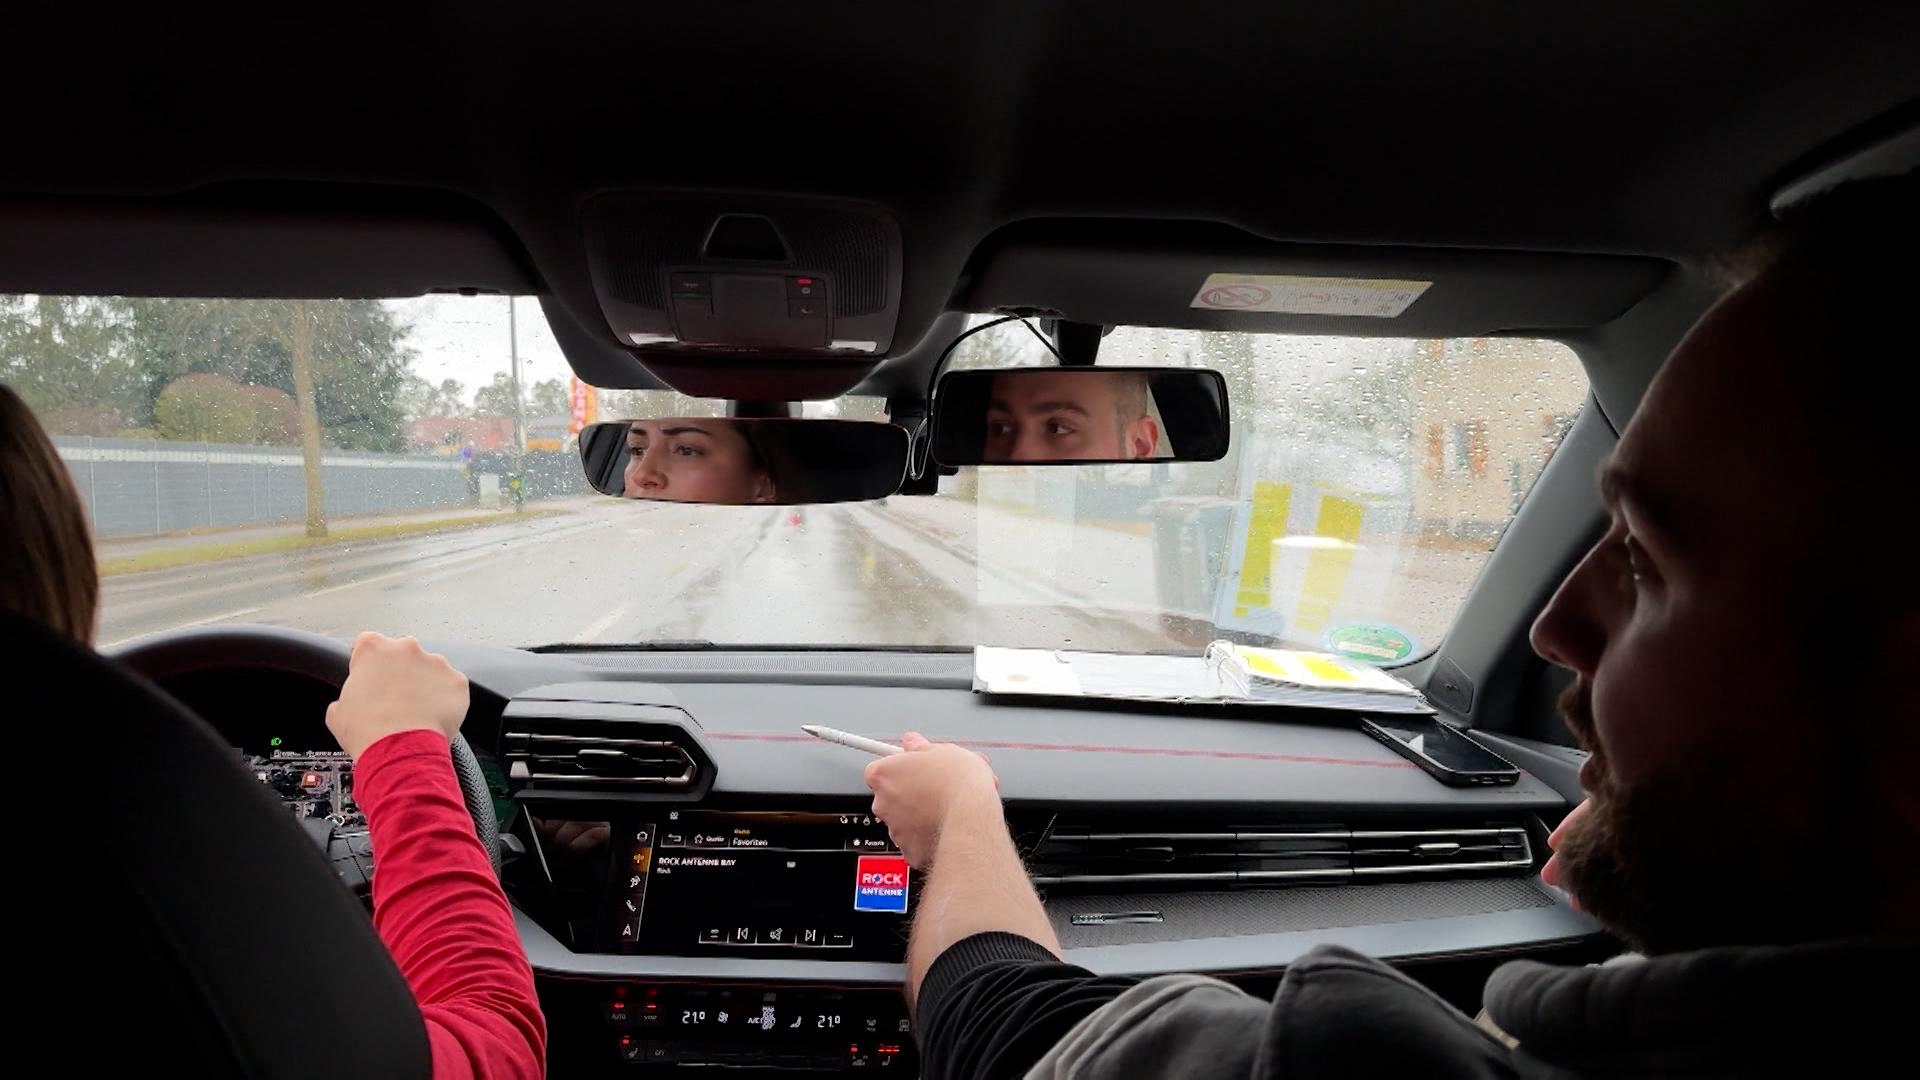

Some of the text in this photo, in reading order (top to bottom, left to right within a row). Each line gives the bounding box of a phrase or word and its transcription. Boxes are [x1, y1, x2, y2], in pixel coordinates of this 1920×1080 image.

[733, 838, 768, 846] Favoriten
[658, 858, 681, 866] ROCK
[681, 858, 719, 866] ANTENNE
[862, 873, 903, 884] ROCK
[861, 888, 902, 896] ANTENNE
